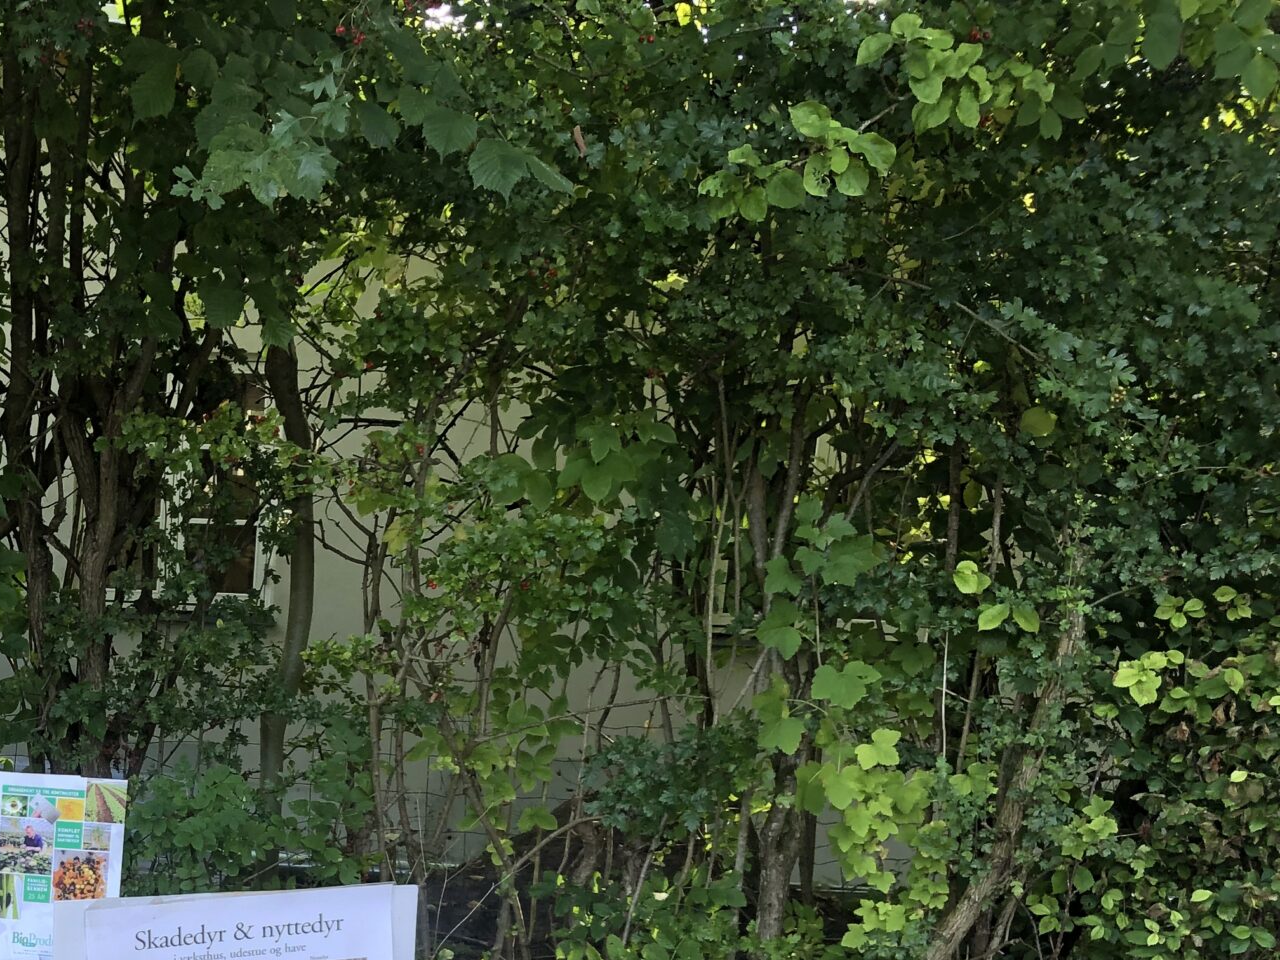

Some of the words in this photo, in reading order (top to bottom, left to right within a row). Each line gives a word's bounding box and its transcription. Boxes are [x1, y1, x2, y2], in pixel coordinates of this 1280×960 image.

[135, 924, 226, 950] Skadedyr
[234, 922, 255, 941] &
[262, 913, 344, 943] nyttedyr
[230, 948, 267, 958] udestue
[270, 946, 282, 957] og
[284, 943, 307, 953] have
